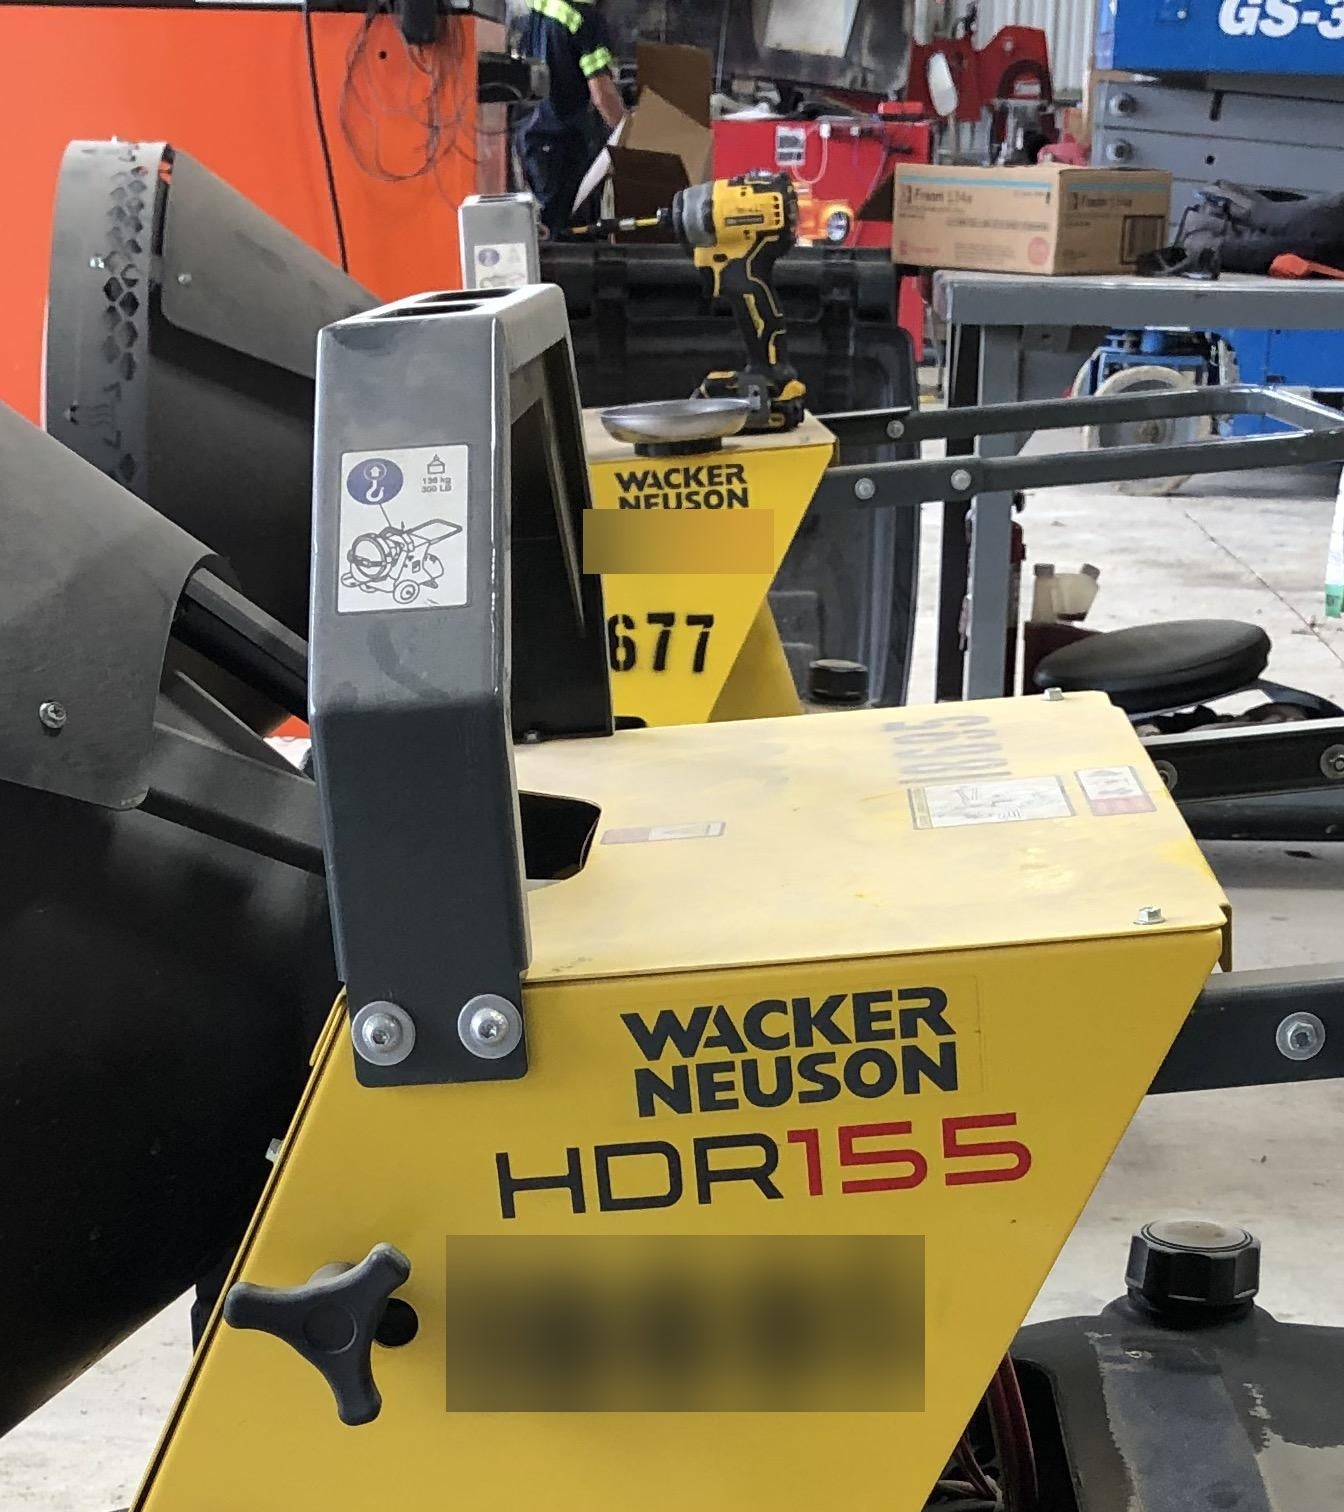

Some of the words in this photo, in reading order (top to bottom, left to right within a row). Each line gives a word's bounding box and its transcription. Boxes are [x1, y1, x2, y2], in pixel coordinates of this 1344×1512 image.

[614, 463, 748, 493] WACKER
[617, 487, 750, 509] NEUSON
[607, 611, 715, 673] 677
[620, 985, 957, 1061] WACKER
[634, 1041, 959, 1118] NEUSON
[495, 1112, 1032, 1219] HDR155
